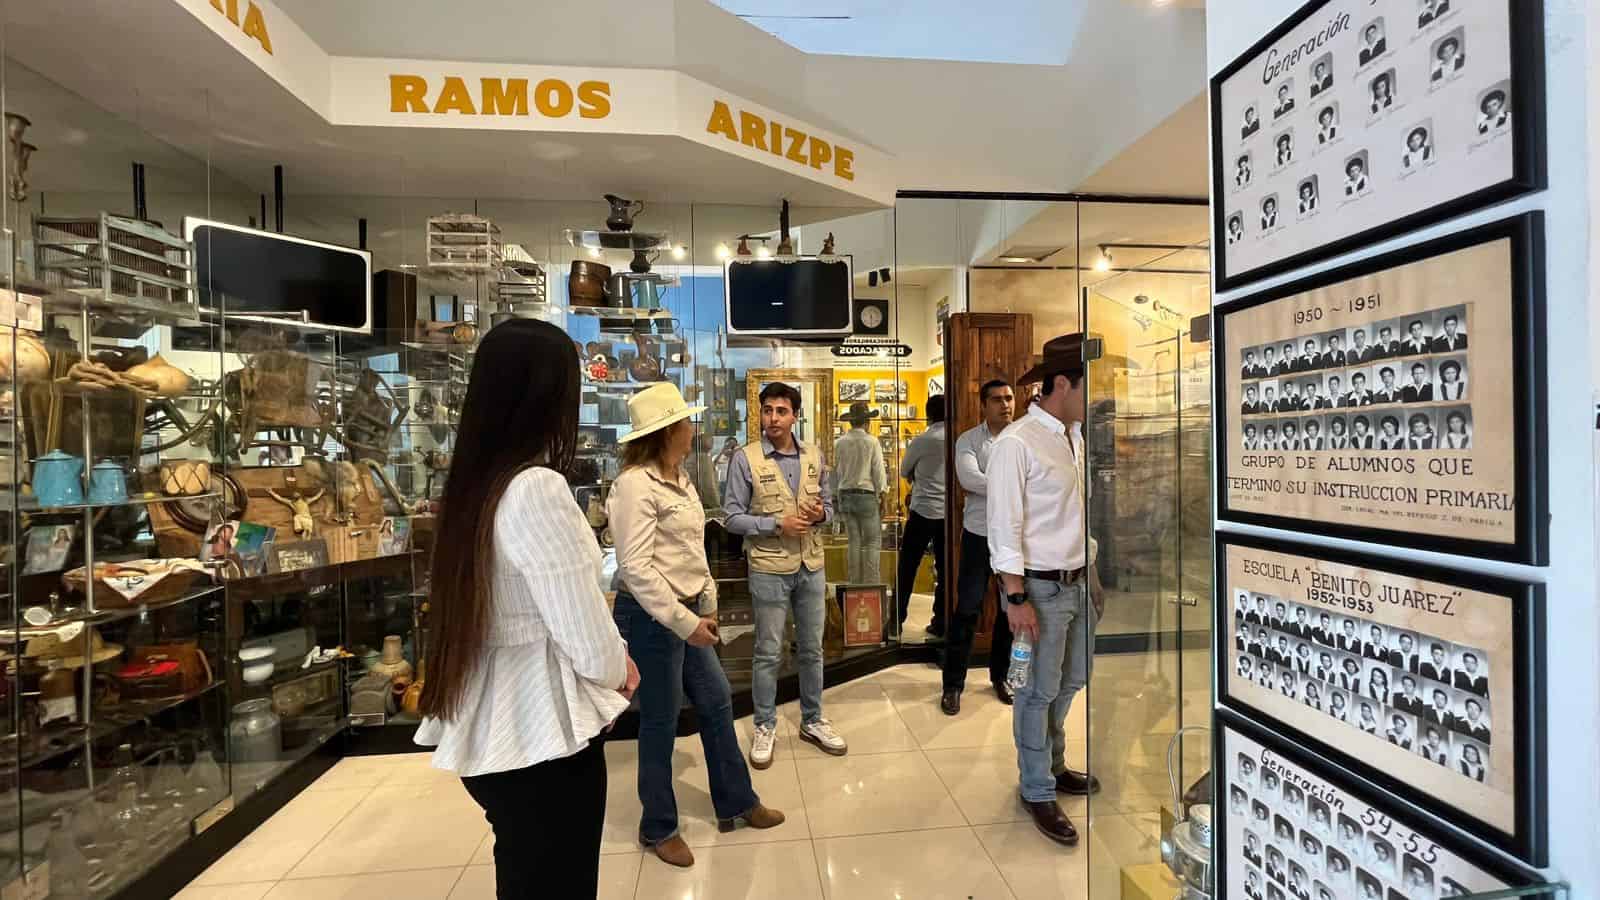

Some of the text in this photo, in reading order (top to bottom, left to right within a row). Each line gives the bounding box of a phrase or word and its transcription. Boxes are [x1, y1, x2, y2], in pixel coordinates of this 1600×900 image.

[1262, 11, 1351, 85] Generación
[389, 74, 855, 182] RAMOS ARIZPE
[1293, 307, 1323, 326] 1950
[1348, 292, 1381, 313] 1951
[1241, 455, 1473, 476] GRUPO DE ALUMNOS QUE
[1226, 476, 1282, 493] TERMINO
[1286, 481, 1307, 495] SU
[1313, 481, 1418, 504] INSTRUCCION
[1243, 559, 1301, 585] ESCUELA
[1306, 588, 1375, 614] 1952-1953
[1260, 748, 1345, 811] Generación
